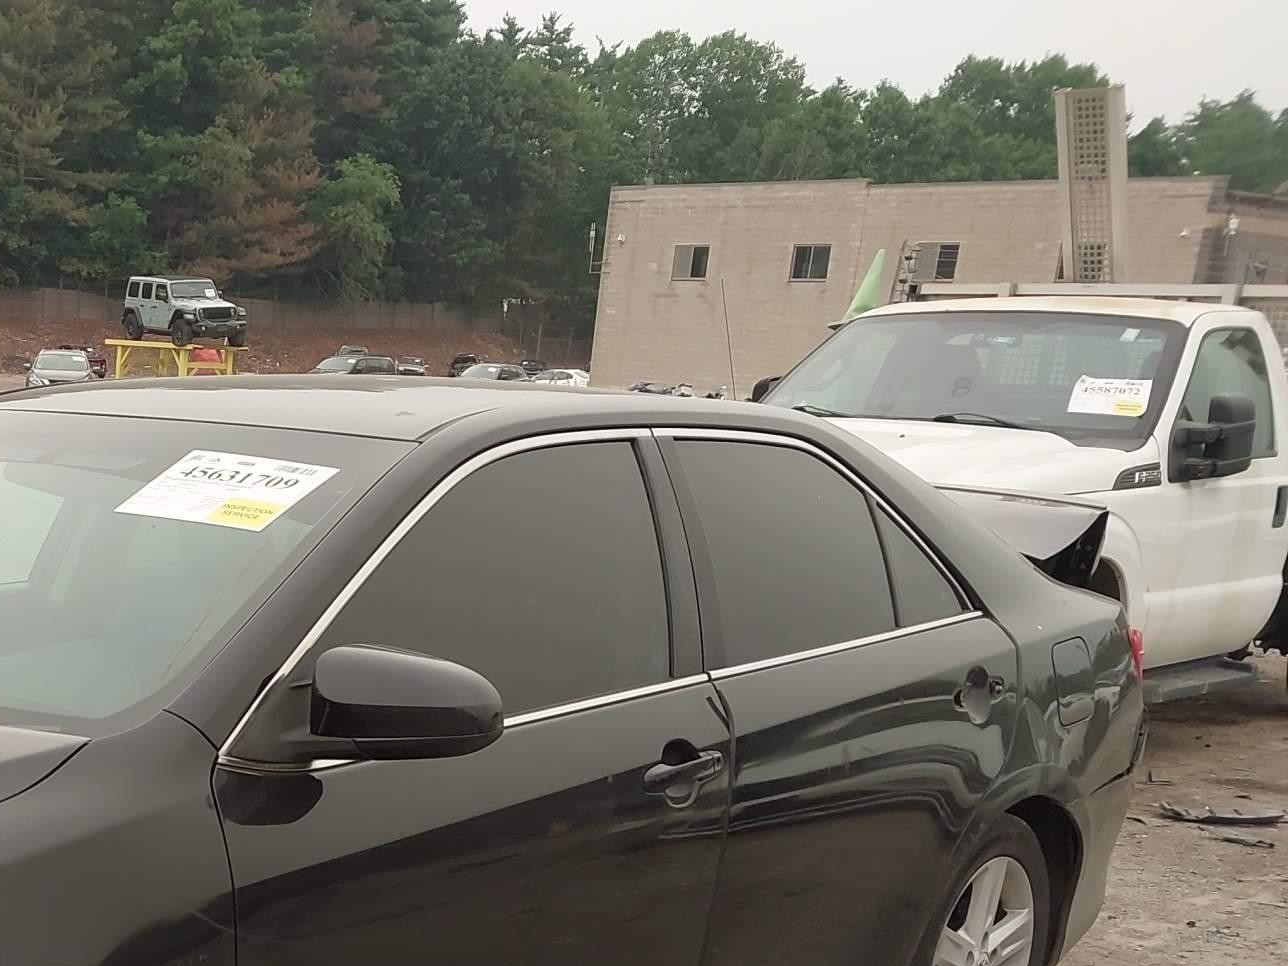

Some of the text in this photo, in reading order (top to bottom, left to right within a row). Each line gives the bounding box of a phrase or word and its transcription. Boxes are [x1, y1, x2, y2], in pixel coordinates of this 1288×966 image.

[1081, 386, 1141, 396] 45587072
[179, 465, 300, 490] 45631709
[220, 510, 261, 520] SERVICE
[222, 503, 275, 516] INSPECTION
